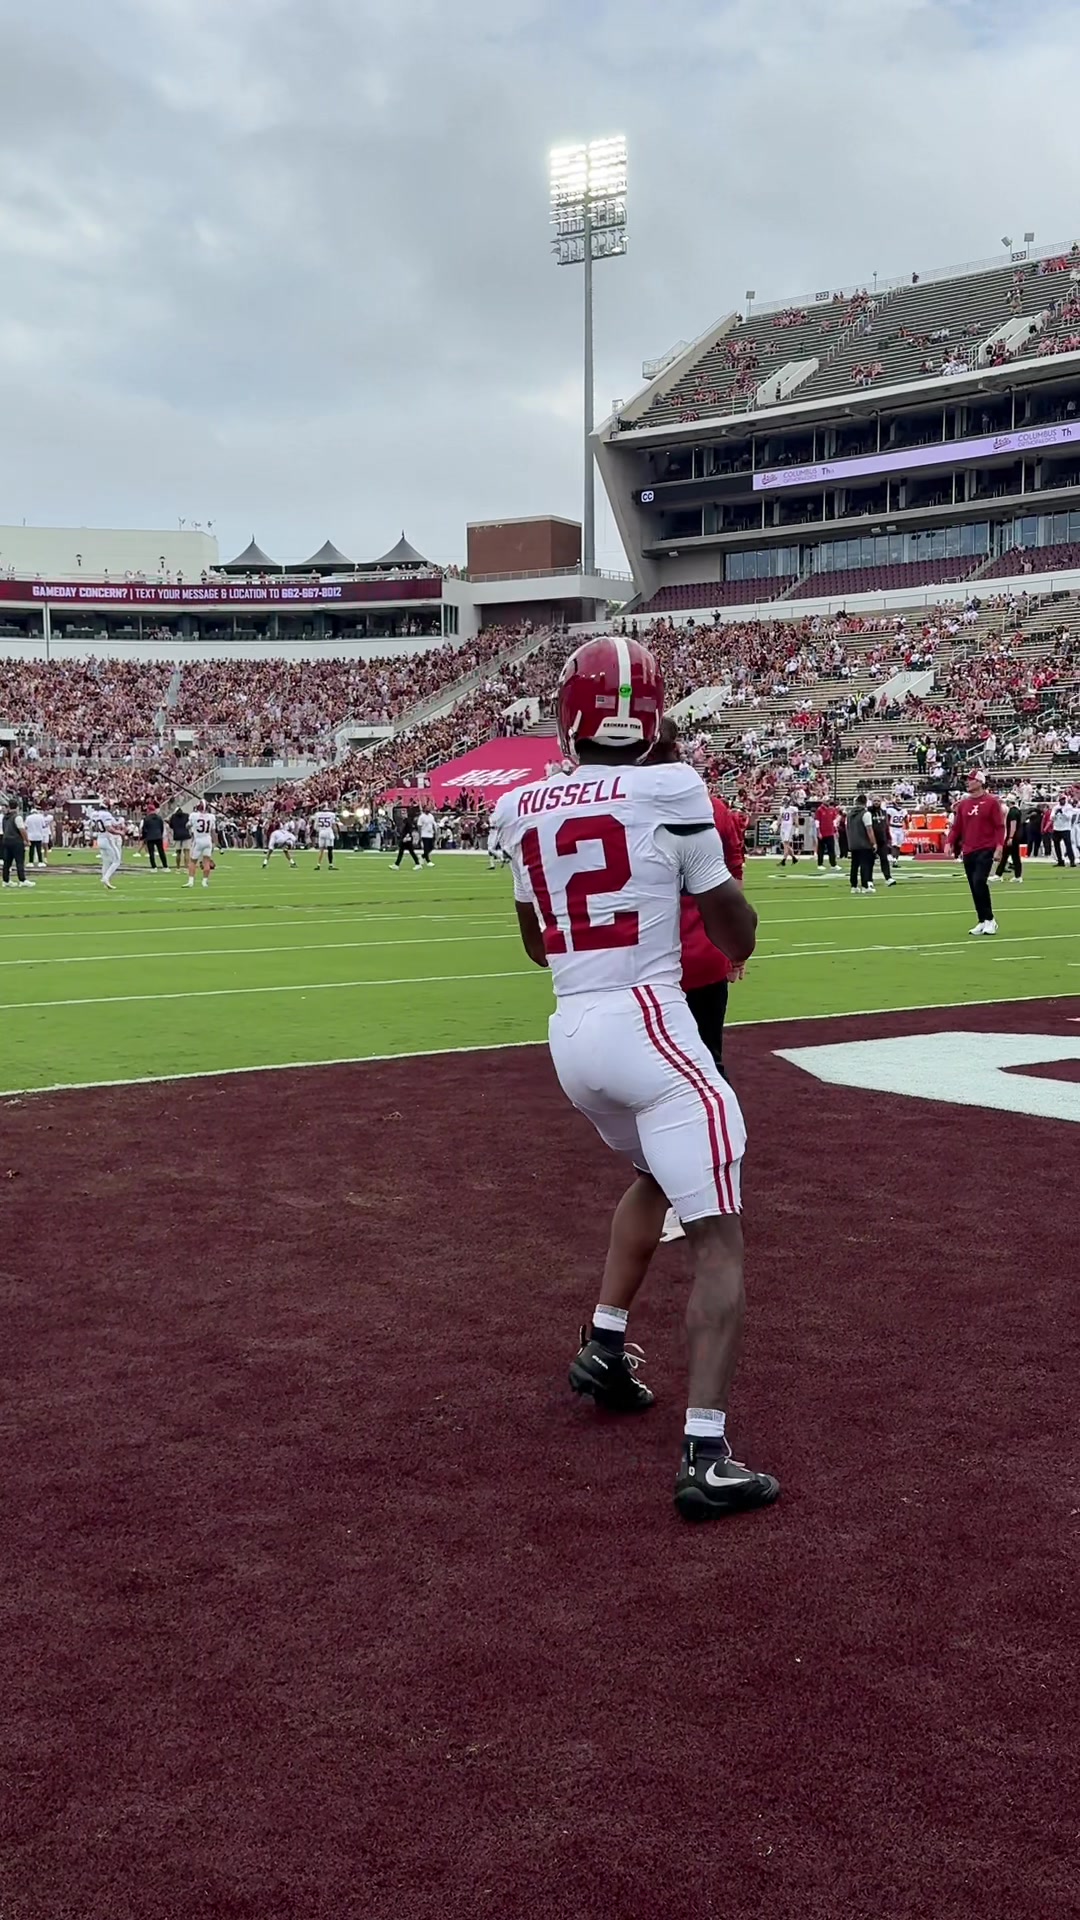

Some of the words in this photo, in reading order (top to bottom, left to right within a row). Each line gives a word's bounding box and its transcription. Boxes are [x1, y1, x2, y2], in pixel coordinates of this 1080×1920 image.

[1017, 429, 1057, 442] COLUMBUS
[642, 492, 654, 502] CC
[32, 586, 77, 598] GAMEDAY
[79, 587, 128, 599] CONCERN?
[135, 588, 156, 599] TEXT
[157, 588, 181, 600] YOUR
[182, 588, 219, 600] MESSAGE
[221, 588, 227, 599] &
[230, 588, 267, 599] LOCATION
[269, 588, 280, 598] TO
[281, 587, 342, 598] 662-667-8012
[517, 776, 627, 817] RUSSELL
[196, 819, 211, 833] 31
[318, 817, 331, 828] 55
[521, 814, 639, 955] 12
